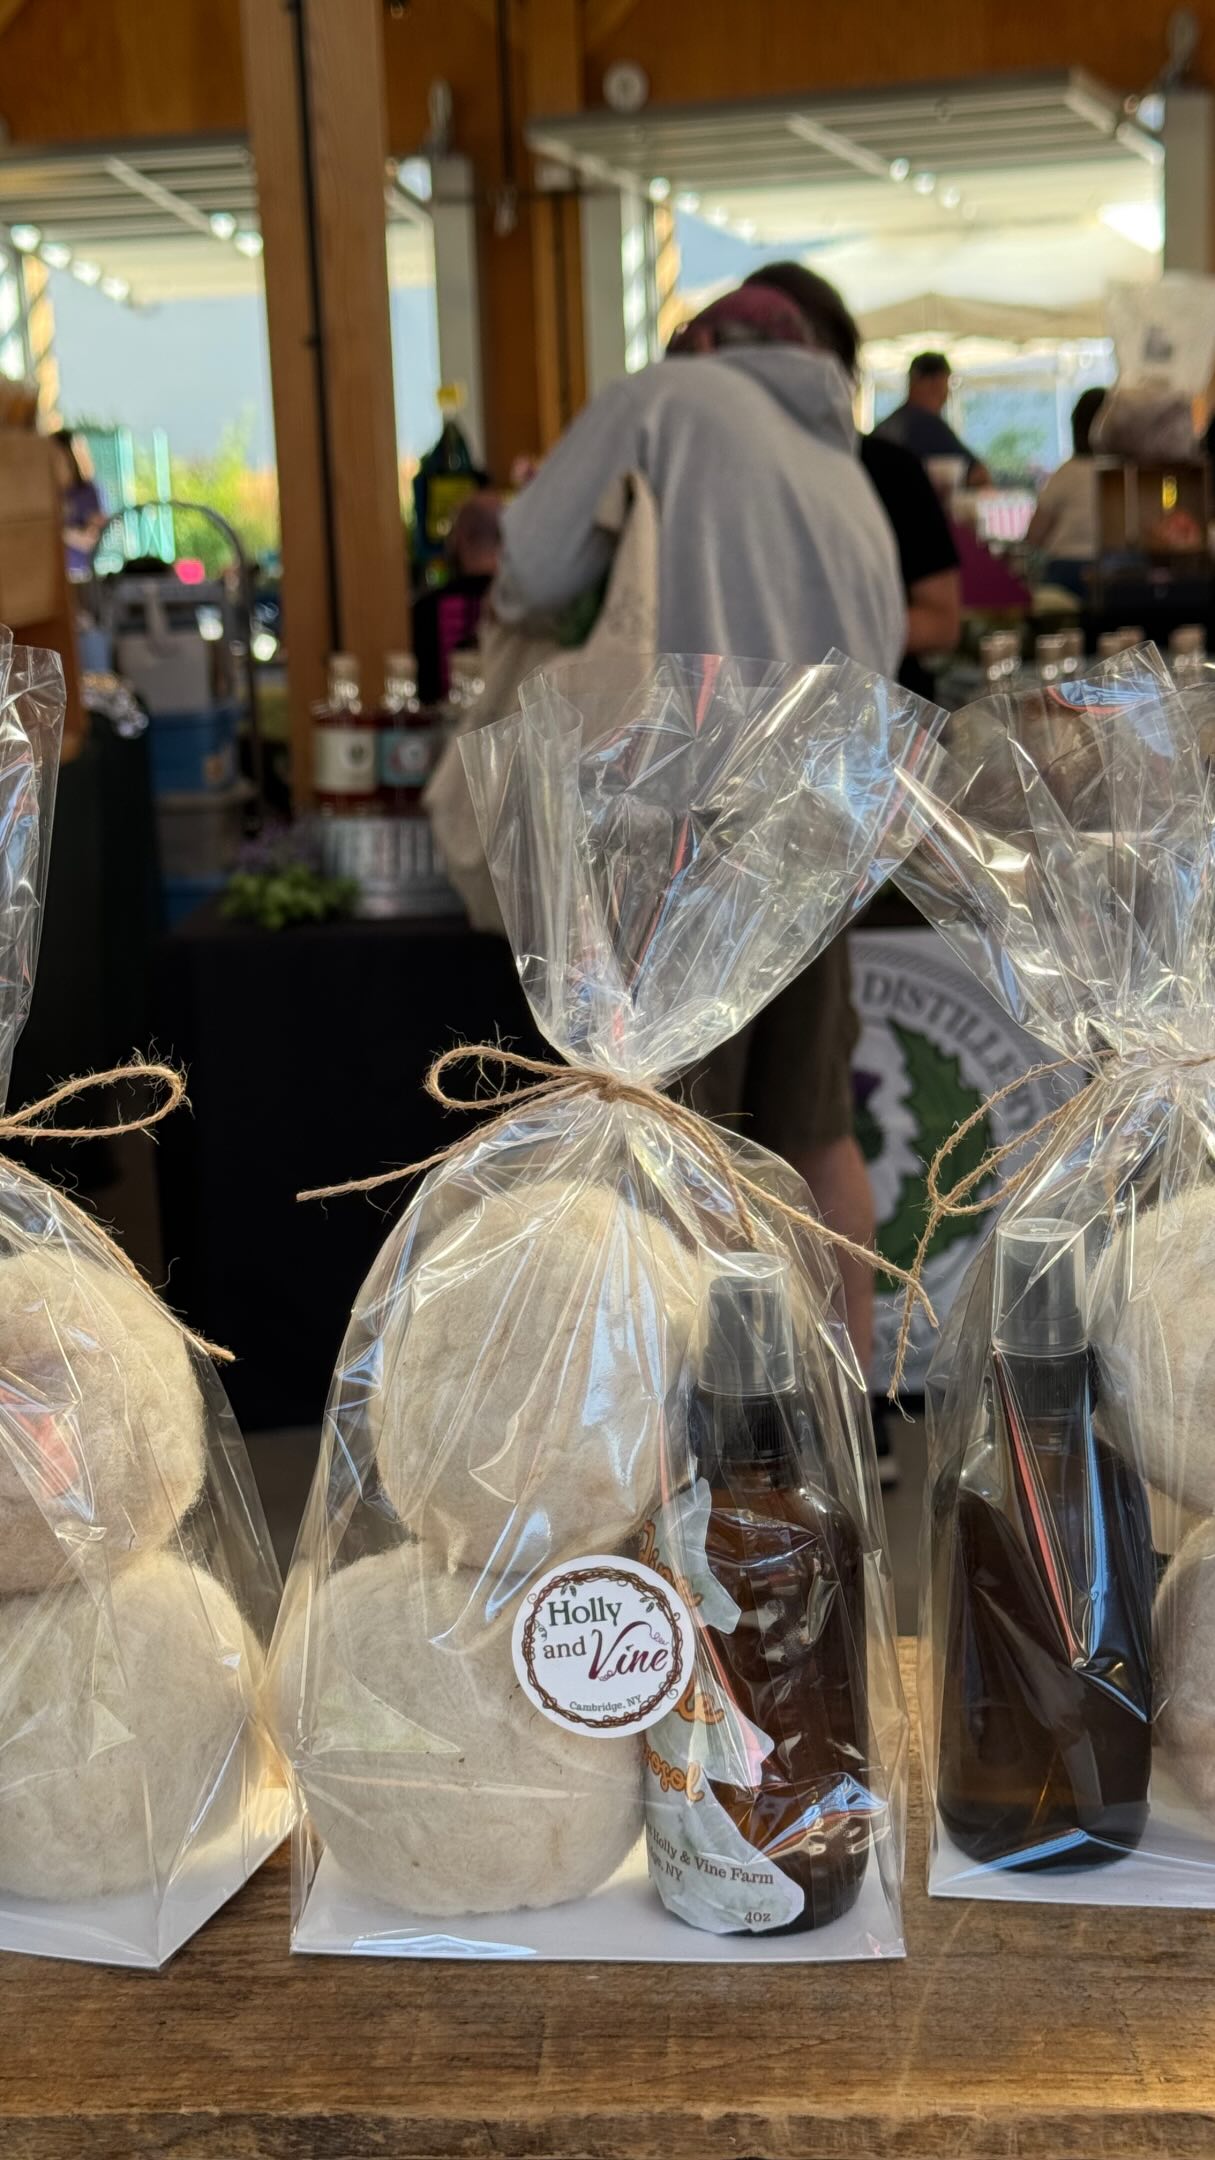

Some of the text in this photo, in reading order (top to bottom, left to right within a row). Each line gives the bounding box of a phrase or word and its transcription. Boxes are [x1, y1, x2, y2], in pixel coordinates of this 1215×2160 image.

[547, 1596, 623, 1627] Holly
[543, 1621, 669, 1681] and Vine
[626, 1694, 642, 1707] NY
[653, 1827, 678, 1860] Holly
[680, 1850, 691, 1865] &
[694, 1855, 727, 1878] Vine
[730, 1867, 774, 1884] Farm
[665, 1860, 683, 1881] NY
